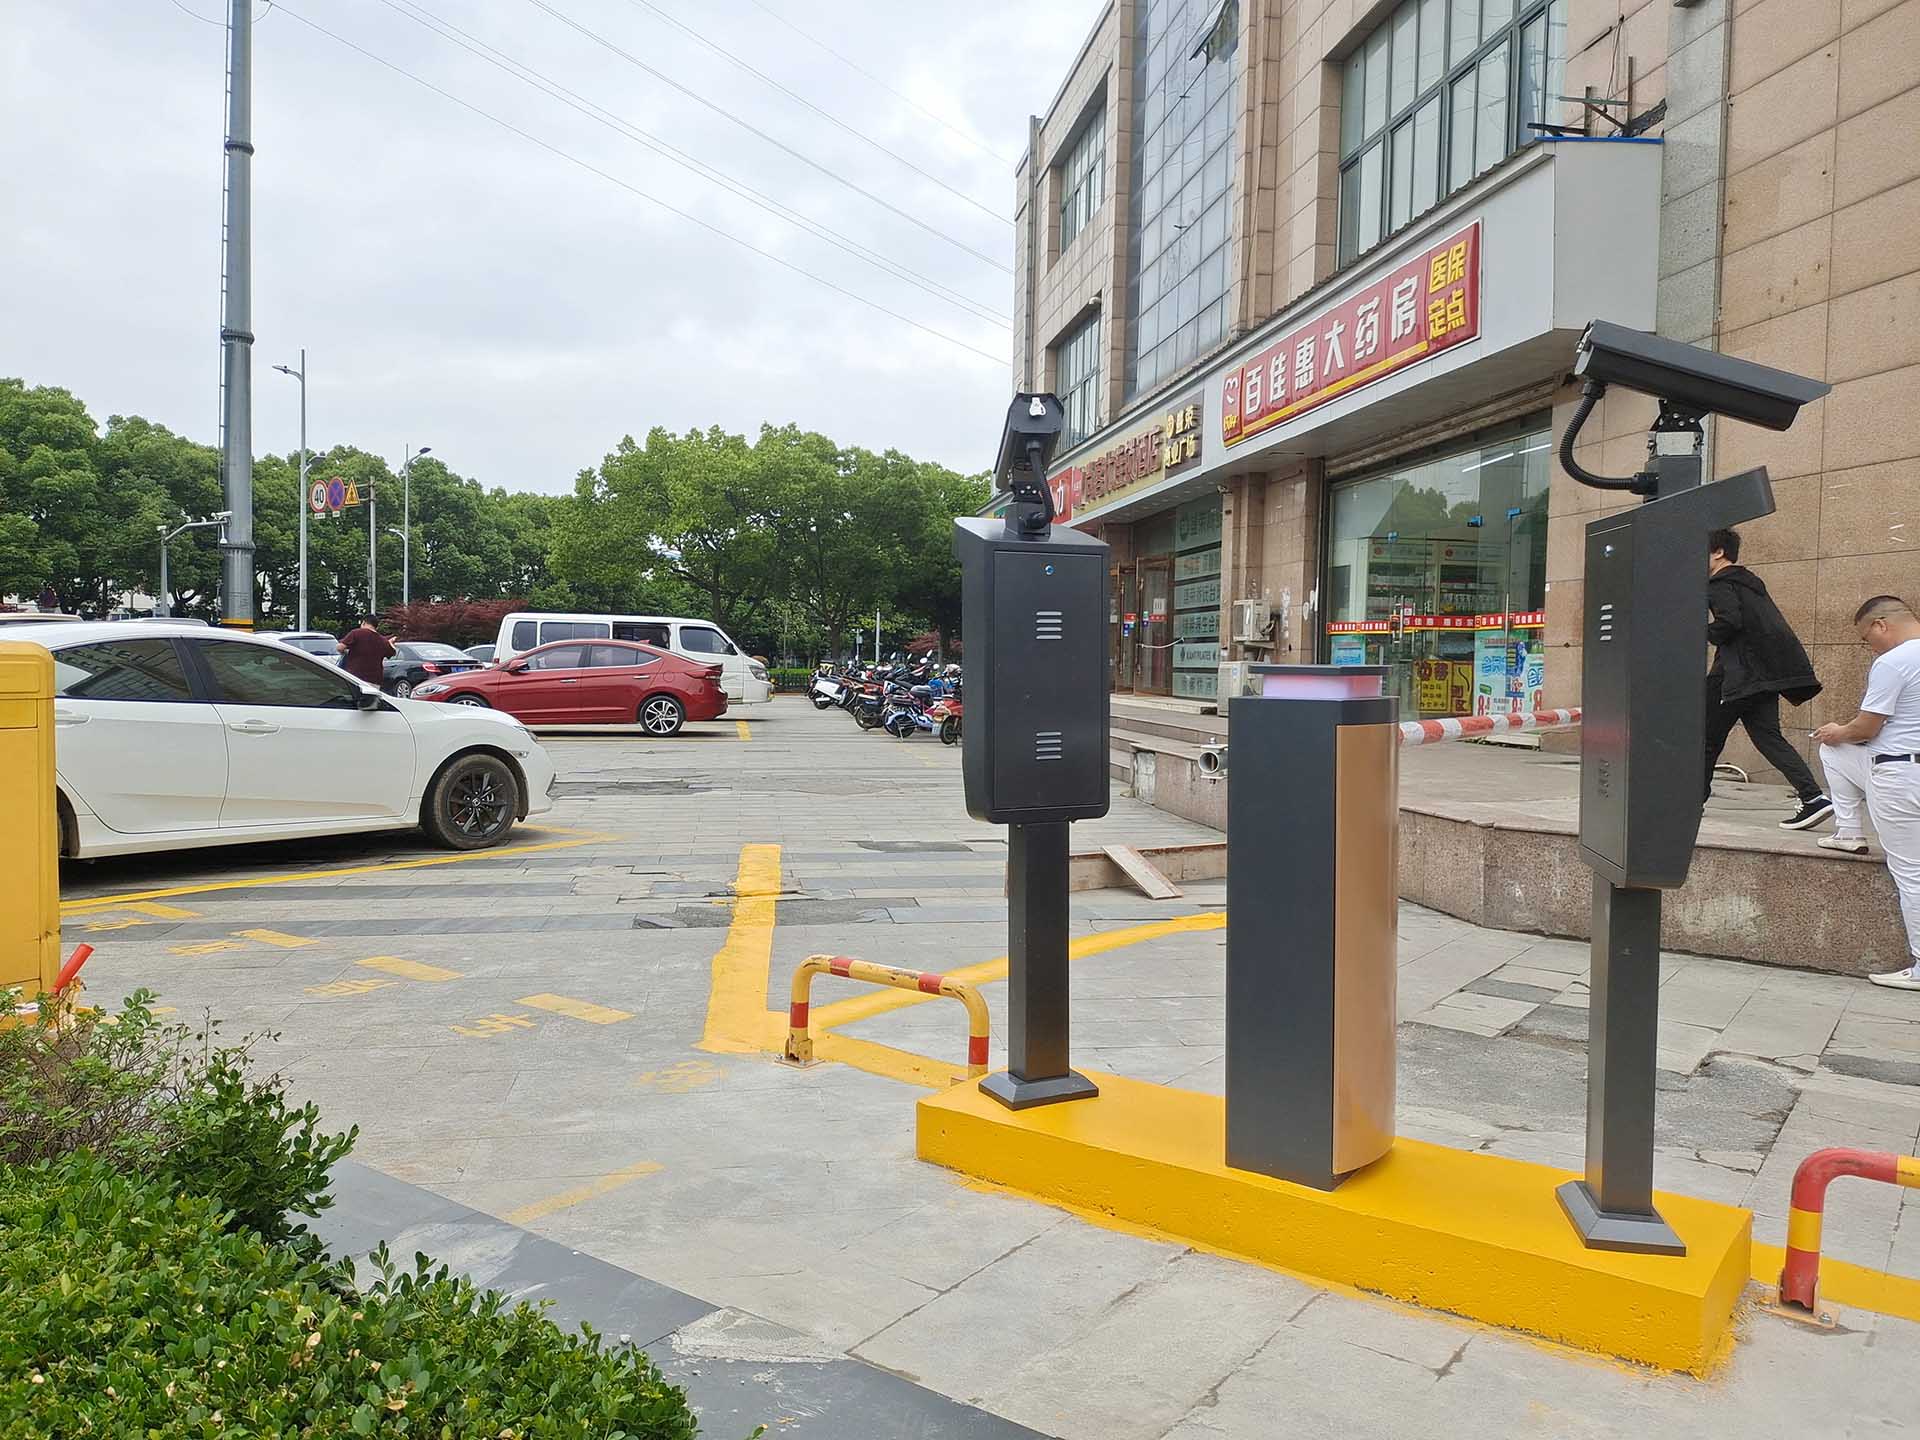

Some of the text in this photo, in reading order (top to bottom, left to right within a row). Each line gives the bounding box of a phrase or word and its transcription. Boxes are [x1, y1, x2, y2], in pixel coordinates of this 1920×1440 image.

[1428, 240, 1468, 294] 医保
[1428, 287, 1467, 340] 定点
[1245, 275, 1418, 415] 百佳惠大药房
[314, 489, 325, 504] 40
